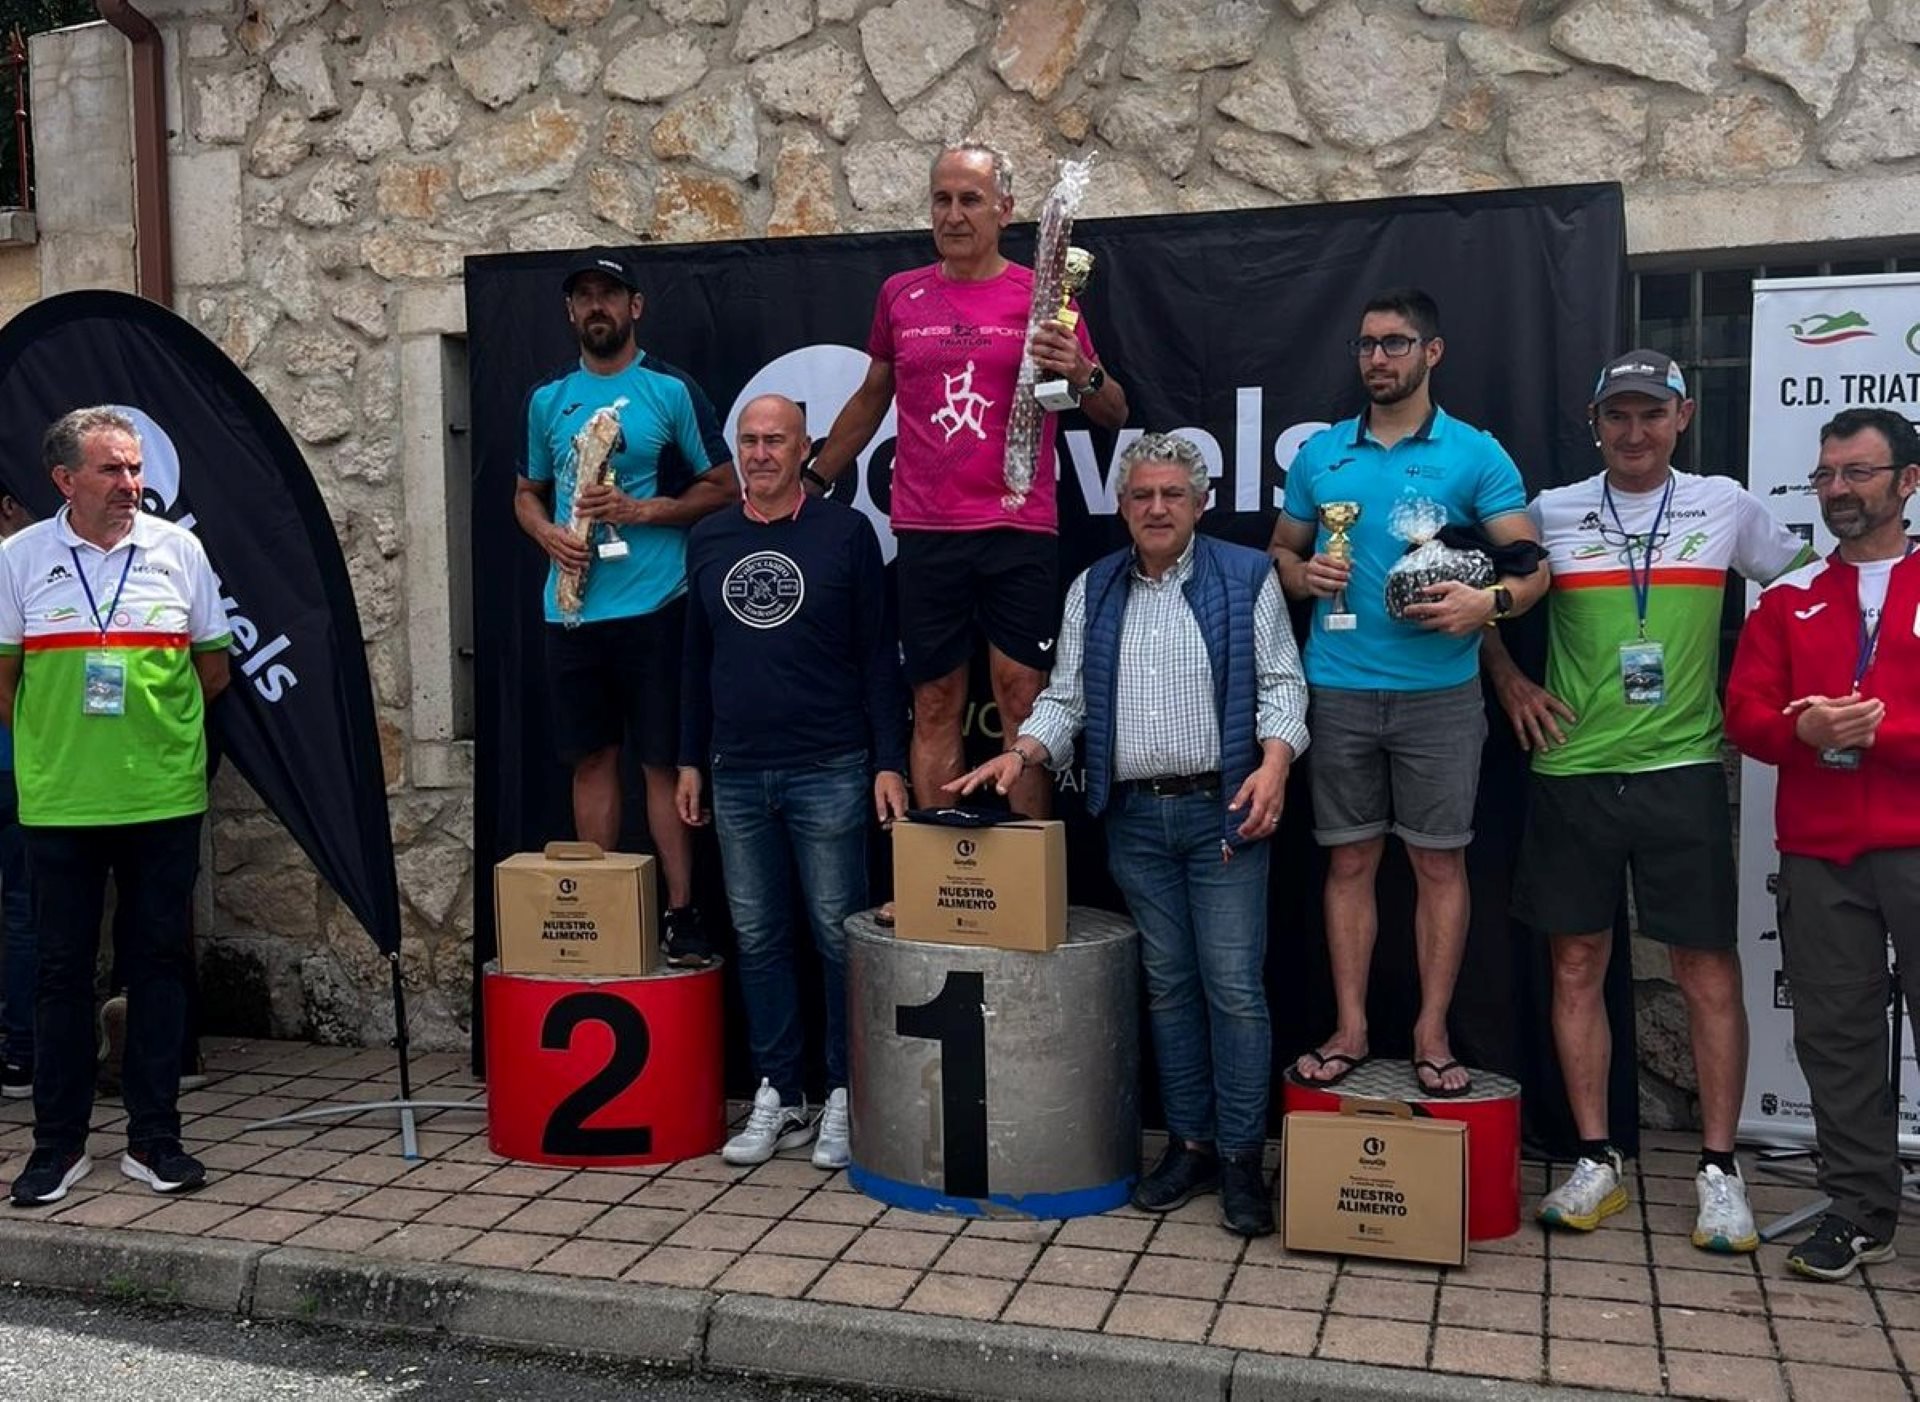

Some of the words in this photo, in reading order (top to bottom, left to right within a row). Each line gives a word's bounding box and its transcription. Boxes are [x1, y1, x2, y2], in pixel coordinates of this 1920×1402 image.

[901, 325, 952, 338] FITNESS
[1780, 376, 1831, 407] C.D.
[1664, 509, 1707, 519] SEGOVIA
[939, 886, 994, 899] NUESTRO
[937, 898, 997, 910] ALIMENTO
[543, 921, 596, 930] NUESTRO
[542, 931, 598, 941] ALIMENTO
[540, 991, 652, 1156] 2
[896, 971, 990, 1199] 1
[1340, 1187, 1405, 1204] NUESTRO
[1337, 1199, 1407, 1217] ALIMENTO
